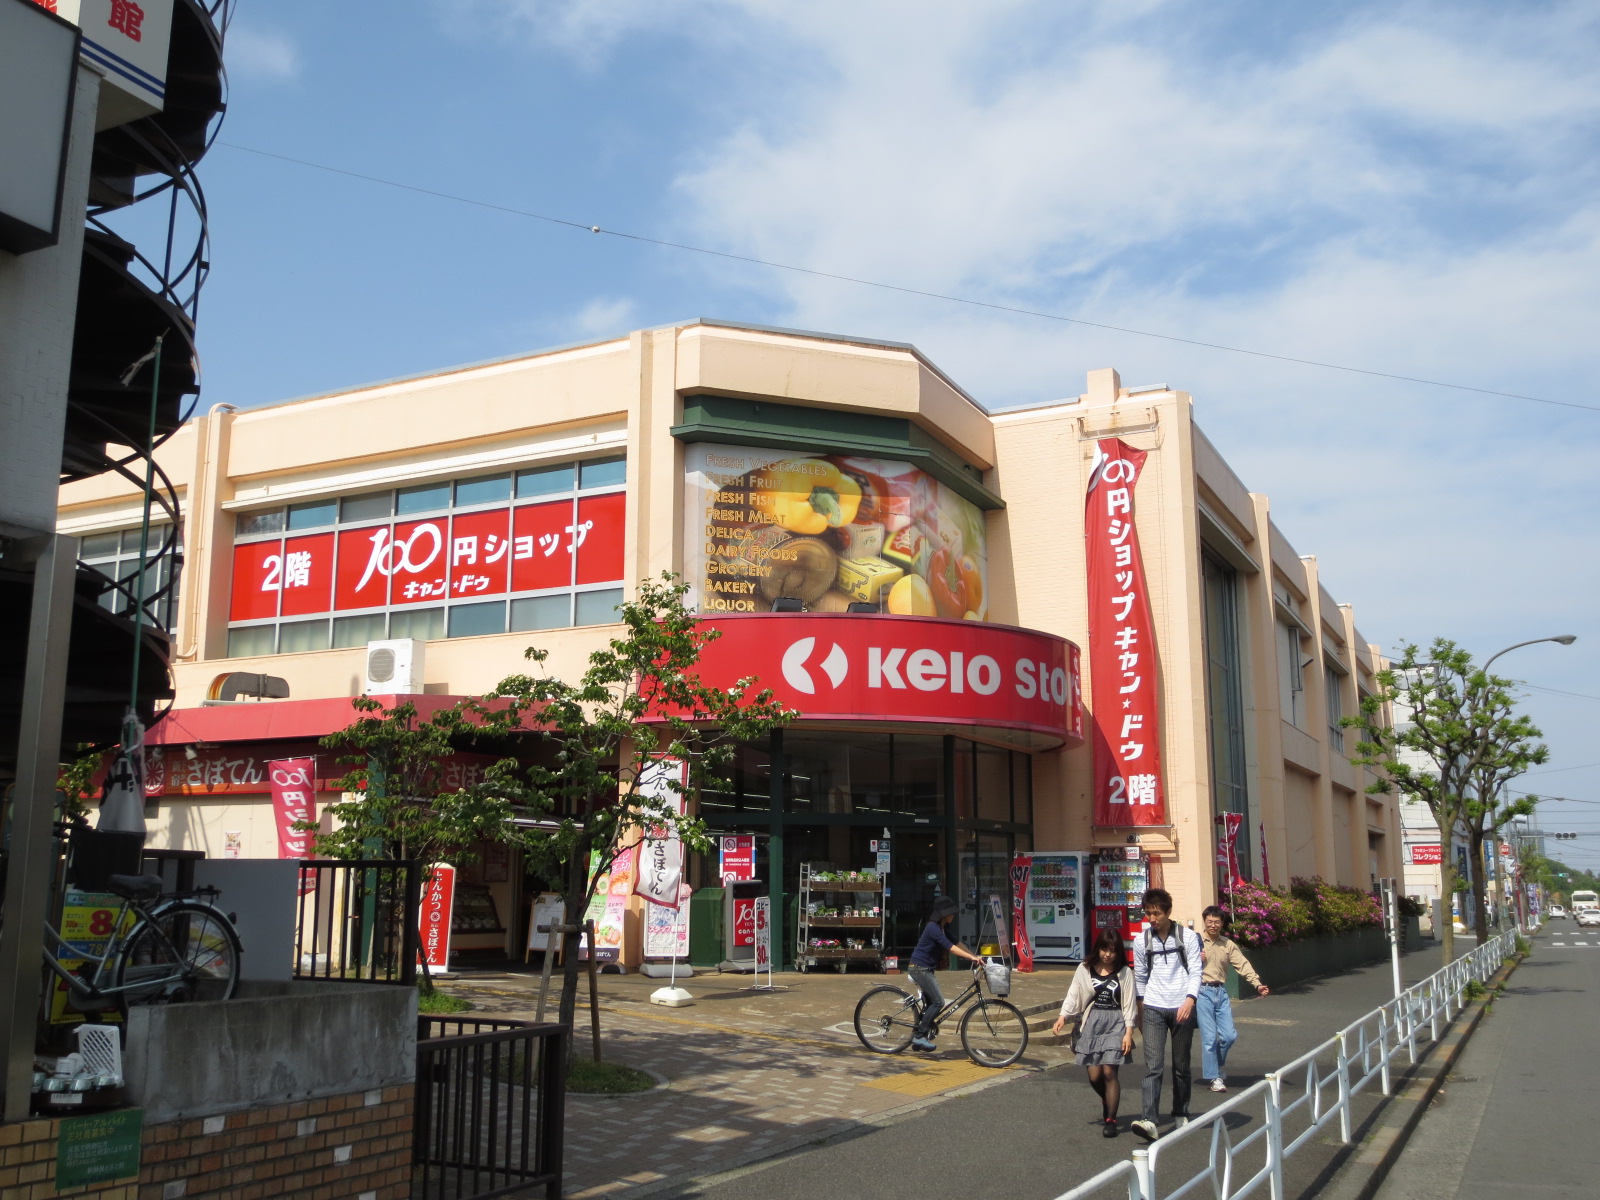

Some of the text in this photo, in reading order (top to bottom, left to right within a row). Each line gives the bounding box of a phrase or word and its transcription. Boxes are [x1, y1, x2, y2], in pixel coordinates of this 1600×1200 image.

[705, 454, 828, 476] FRESH VEGETABLES
[705, 471, 745, 487] FRESH
[705, 507, 786, 524] FRESH MEAT
[705, 525, 755, 541] DELICA
[705, 543, 798, 561] DAIRY FOODS
[261, 551, 312, 592] 2階
[705, 561, 773, 578] GROCERY
[703, 578, 756, 594] BAKERY
[703, 596, 756, 612] LIQUOR
[186, 756, 263, 786] さぼてん
[1108, 773, 1156, 806] 2階
[650, 841, 667, 896] さぼてん
[426, 927, 439, 963] さぼてん
